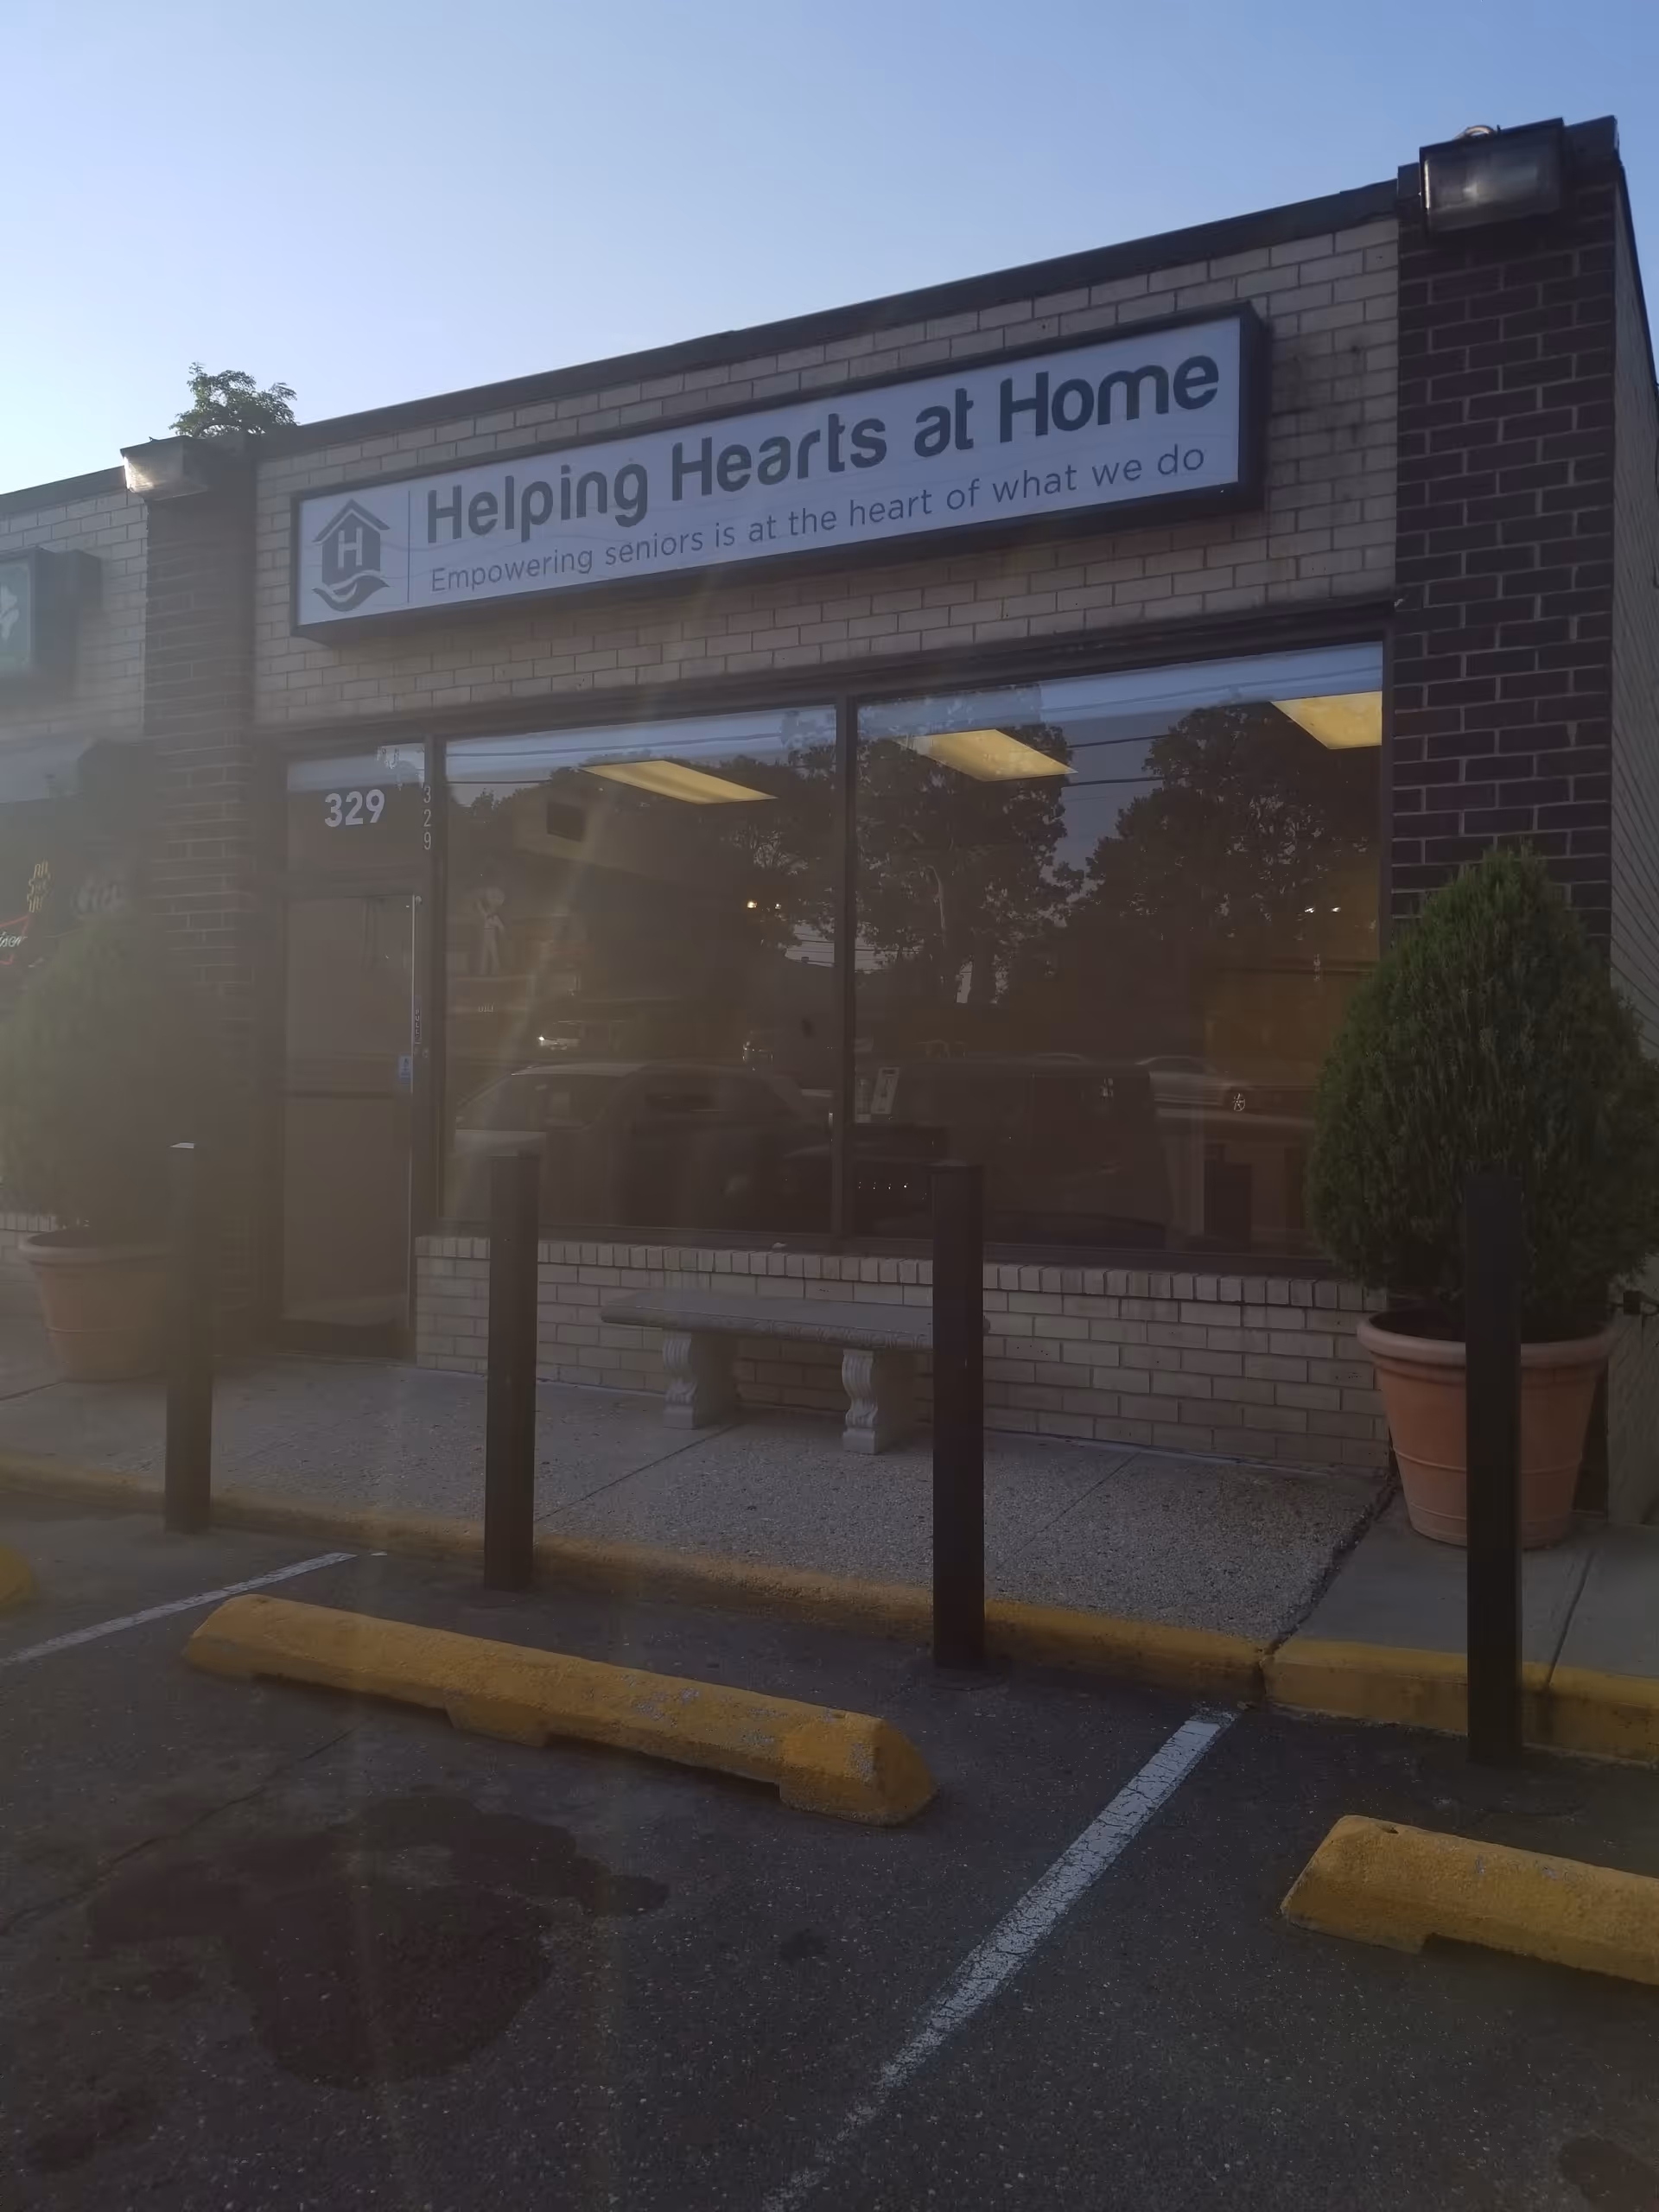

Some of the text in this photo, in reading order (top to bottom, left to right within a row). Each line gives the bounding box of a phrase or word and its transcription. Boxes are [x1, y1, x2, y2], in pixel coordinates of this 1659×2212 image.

[427, 354, 1219, 543] Helping Hearts at Home
[337, 527, 363, 570] H
[432, 443, 1205, 593] Empowering seniors is at the heart of what we do
[324, 789, 385, 828] 329
[423, 785, 432, 850] 329
